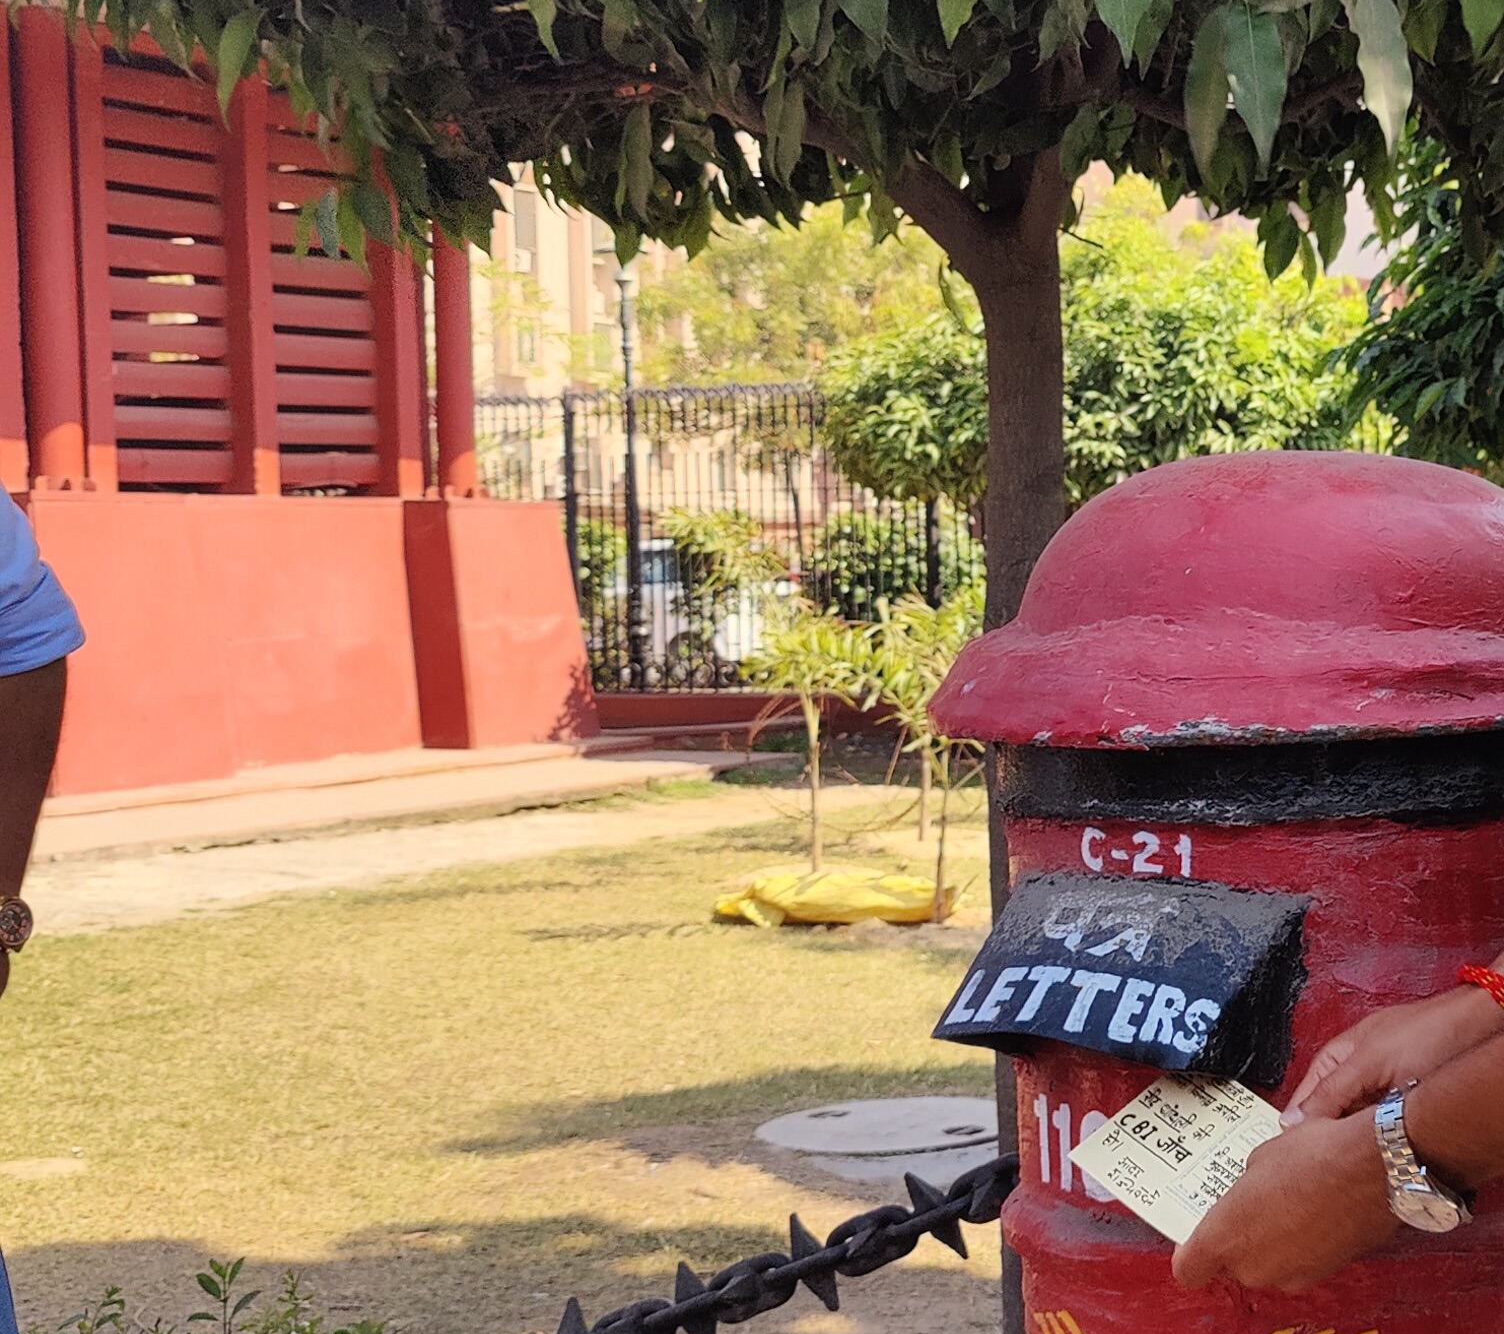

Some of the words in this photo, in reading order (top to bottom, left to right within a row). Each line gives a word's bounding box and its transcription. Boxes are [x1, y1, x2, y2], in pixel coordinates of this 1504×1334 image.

[1081, 826, 1193, 878] C-21
[944, 965, 1221, 1054] LETTERS
[1120, 1113, 1158, 1141] CBI
